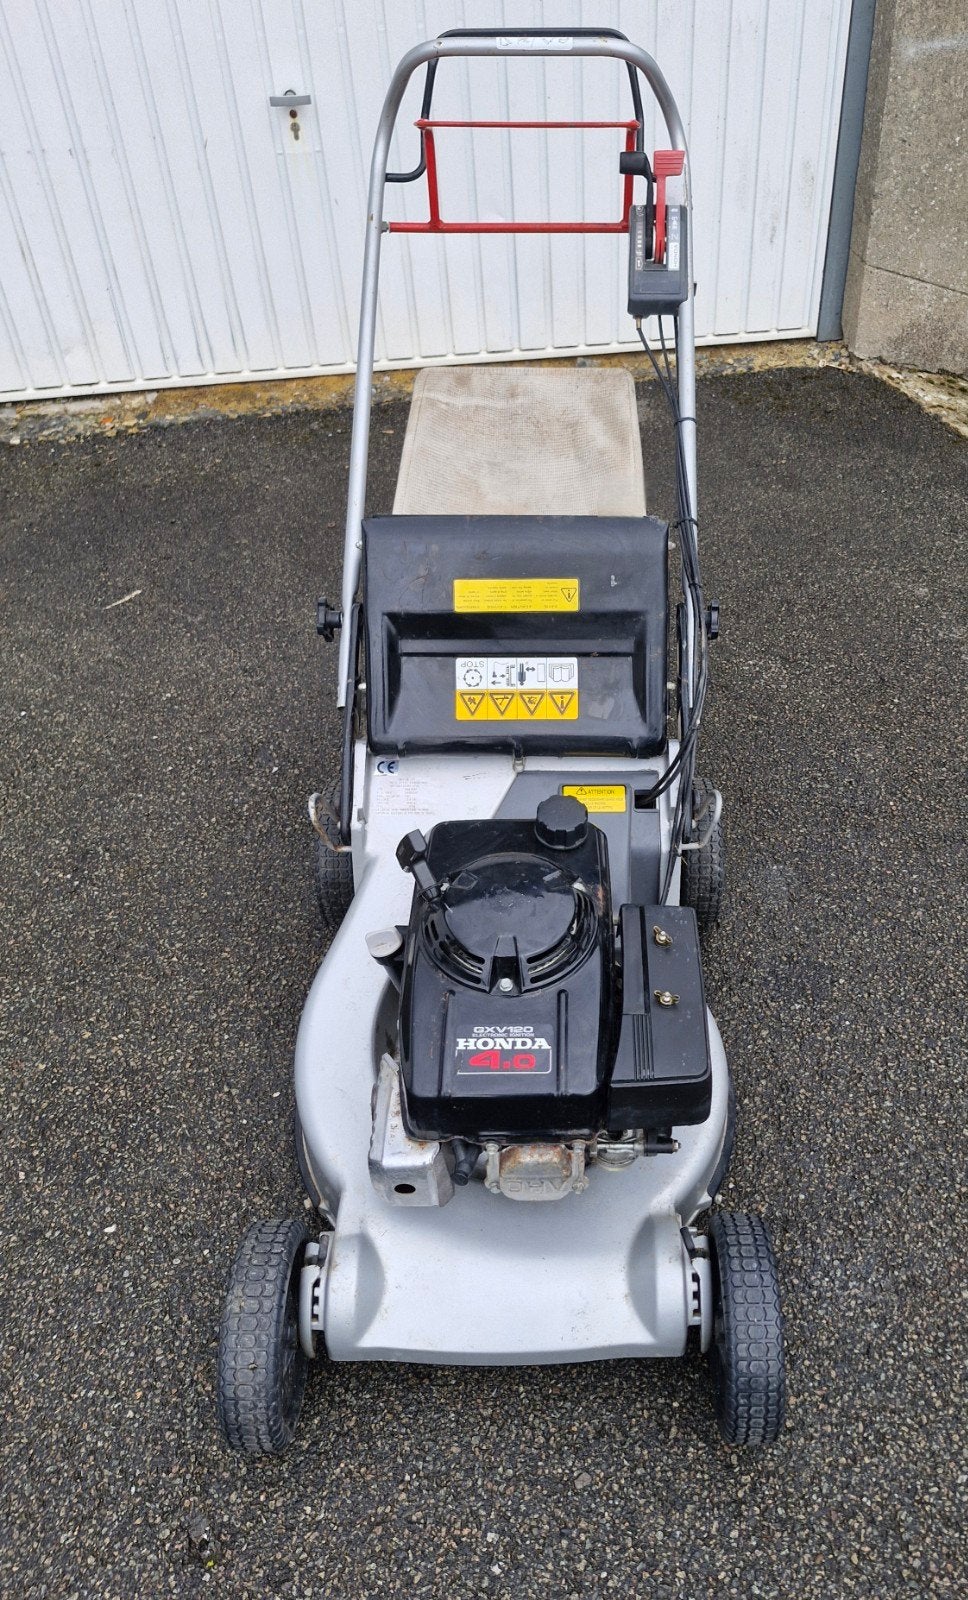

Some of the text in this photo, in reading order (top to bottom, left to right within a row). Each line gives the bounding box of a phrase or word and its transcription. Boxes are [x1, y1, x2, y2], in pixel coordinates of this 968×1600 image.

[460, 660, 485, 668] STOP
[376, 760, 397, 774] CE
[456, 1037, 552, 1050] HONDA
[468, 1049, 537, 1071] 4.0
[506, 1179, 568, 1193] OHV
